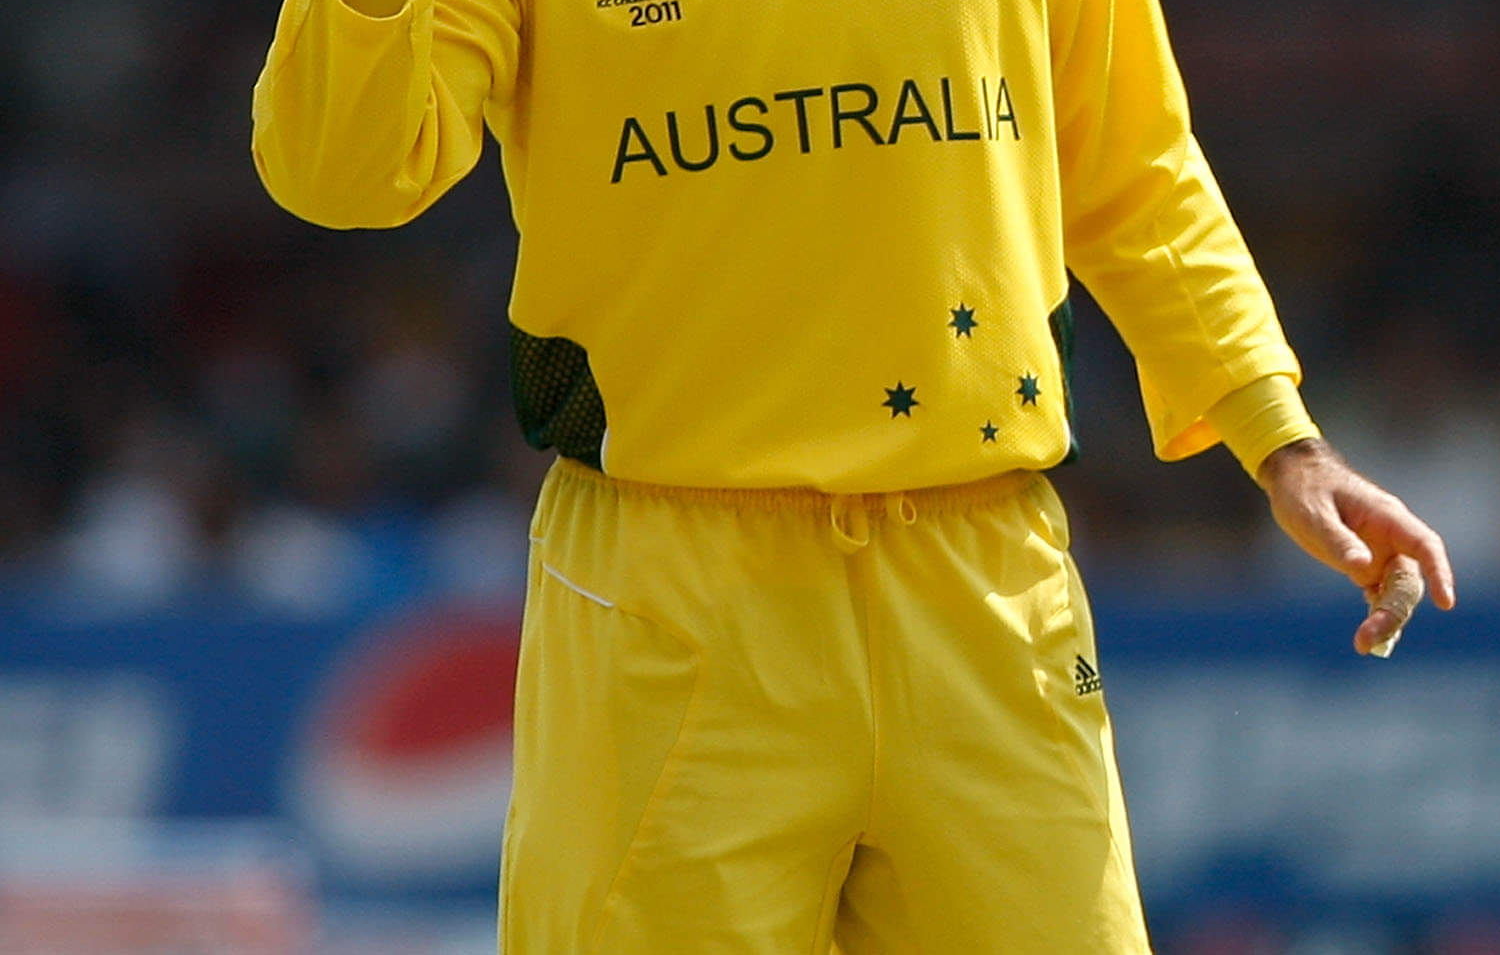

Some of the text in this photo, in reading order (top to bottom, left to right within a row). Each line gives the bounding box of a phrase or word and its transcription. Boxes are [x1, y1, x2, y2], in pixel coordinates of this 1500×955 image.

[629, 0, 683, 27] 2011
[610, 77, 1021, 184] AUSTRALIA
[1075, 677, 1102, 696] adida
